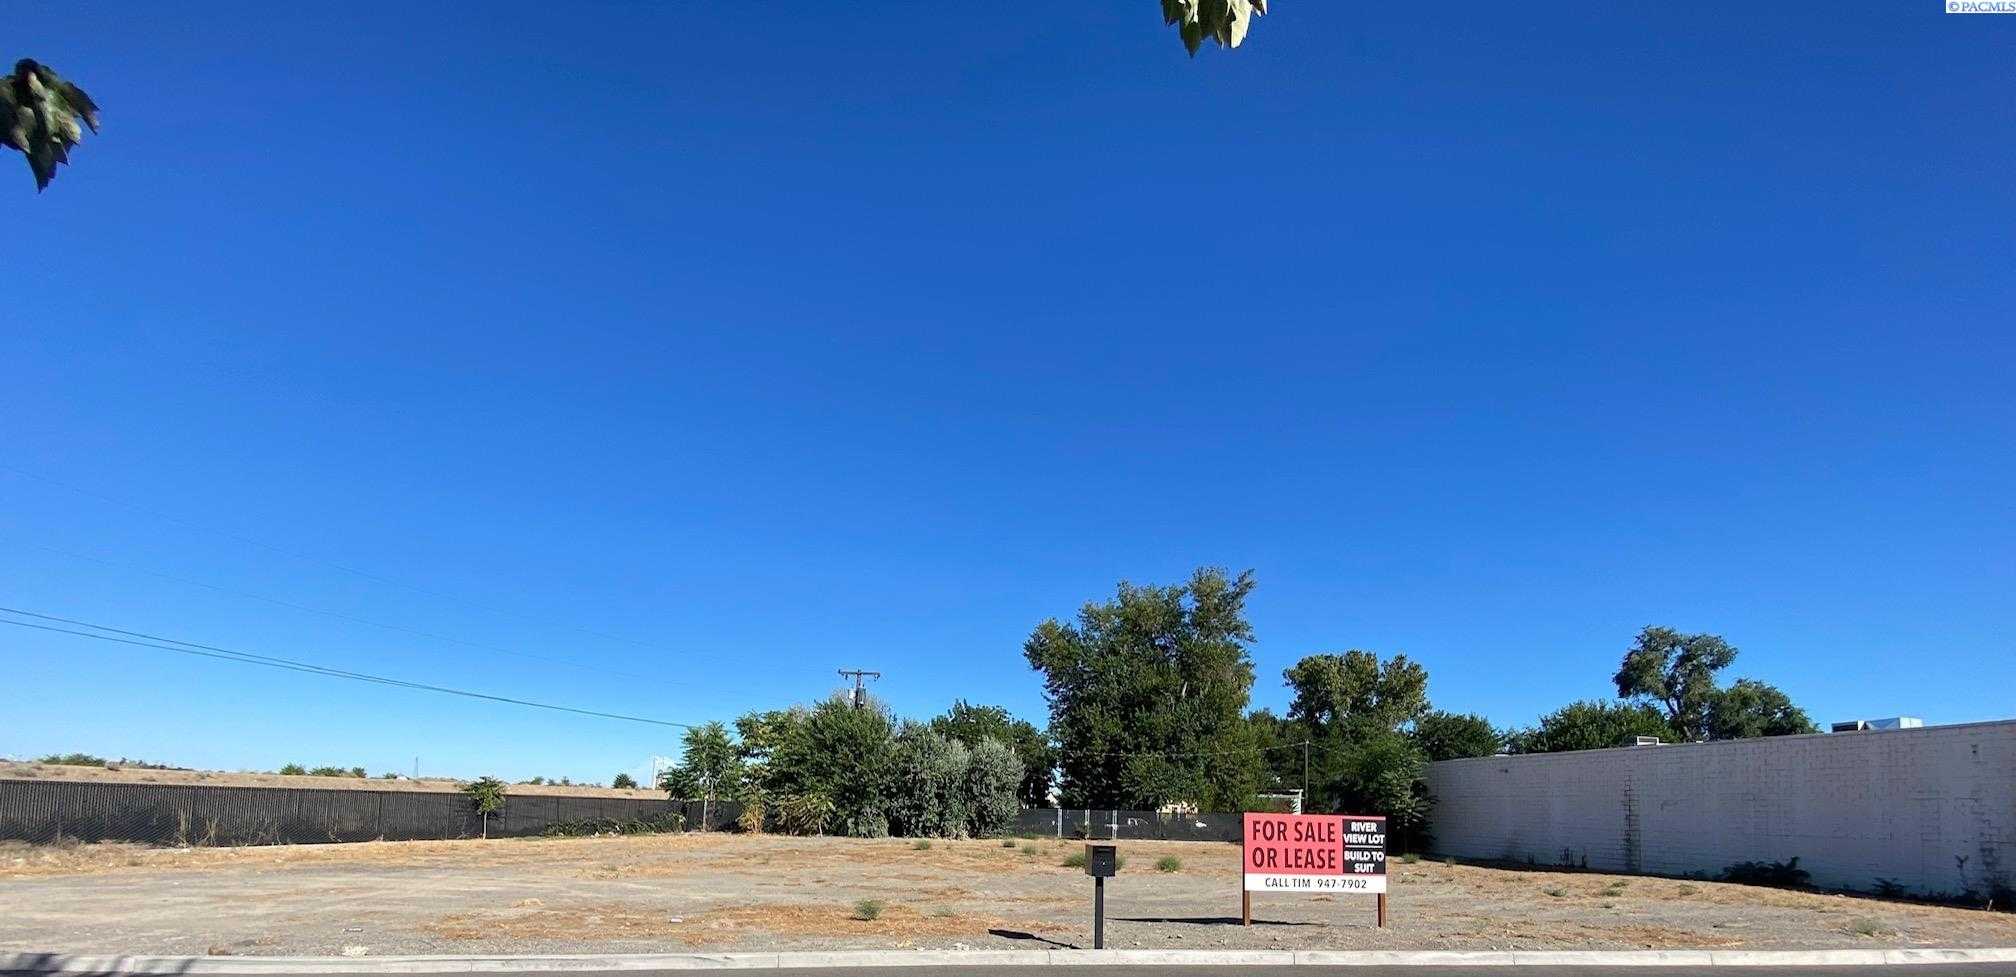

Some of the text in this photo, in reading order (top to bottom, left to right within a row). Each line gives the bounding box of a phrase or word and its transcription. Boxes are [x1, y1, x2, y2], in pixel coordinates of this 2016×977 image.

[1252, 820, 1336, 843] FOR SALE
[1350, 822, 1377, 833] RIVER
[1343, 834, 1385, 844] VIEW LOT
[1252, 847, 1336, 869] OR LEASE
[1344, 850, 1385, 862] BUILD TO
[1354, 863, 1375, 873] SUIT
[1265, 877, 1367, 889] CALL TIM 947-7902
